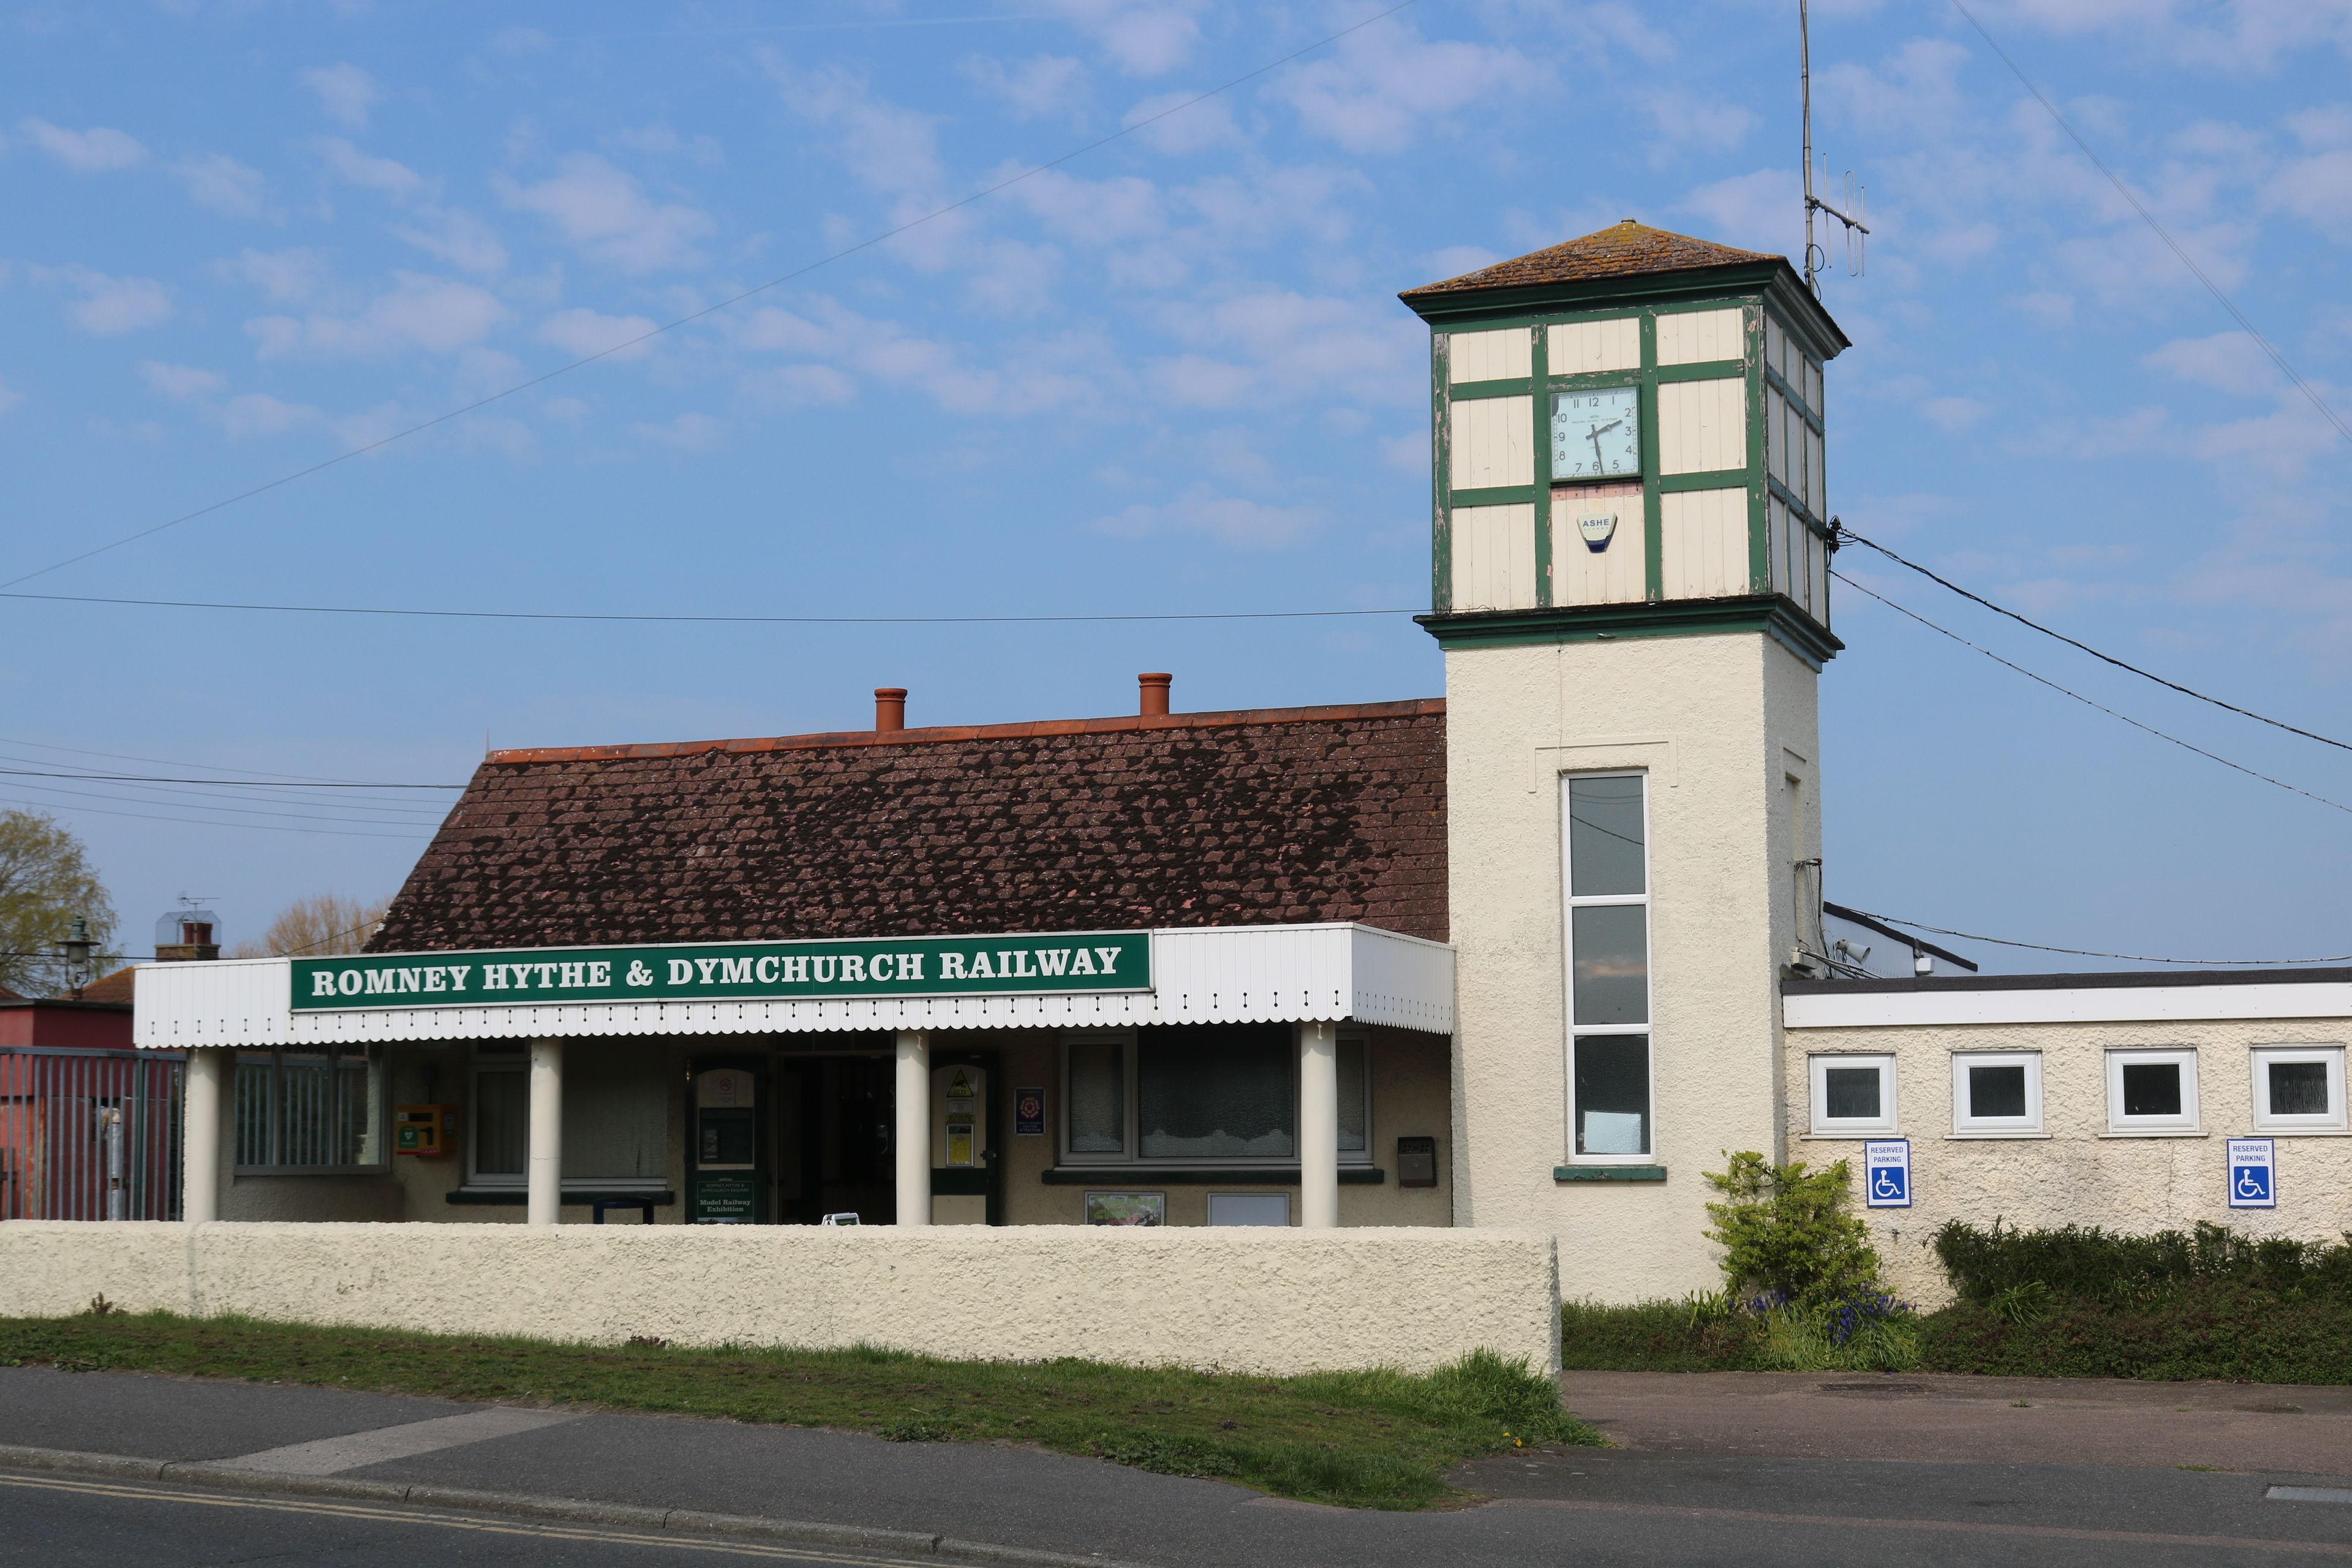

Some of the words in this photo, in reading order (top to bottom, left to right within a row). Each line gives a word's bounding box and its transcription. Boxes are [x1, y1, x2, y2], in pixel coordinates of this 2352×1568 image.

[1574, 399, 1580, 409] 11
[1589, 398, 1599, 407] 12
[1611, 396, 1615, 405] 1
[1624, 408, 1632, 417] 2
[1558, 413, 1567, 423] 10
[1625, 426, 1632, 436] 3
[1558, 432, 1566, 442] 9
[1625, 445, 1633, 454] 4
[1558, 451, 1566, 460] 8
[1575, 462, 1582, 472] 7
[1592, 461, 1599, 471] 6
[1612, 460, 1619, 469] 5
[312, 965, 471, 996] ROMNEY
[483, 961, 611, 990] HYTHE
[626, 960, 654, 987] &
[667, 953, 924, 985] DYMCHURCH
[939, 947, 1121, 979] RAILWAY
